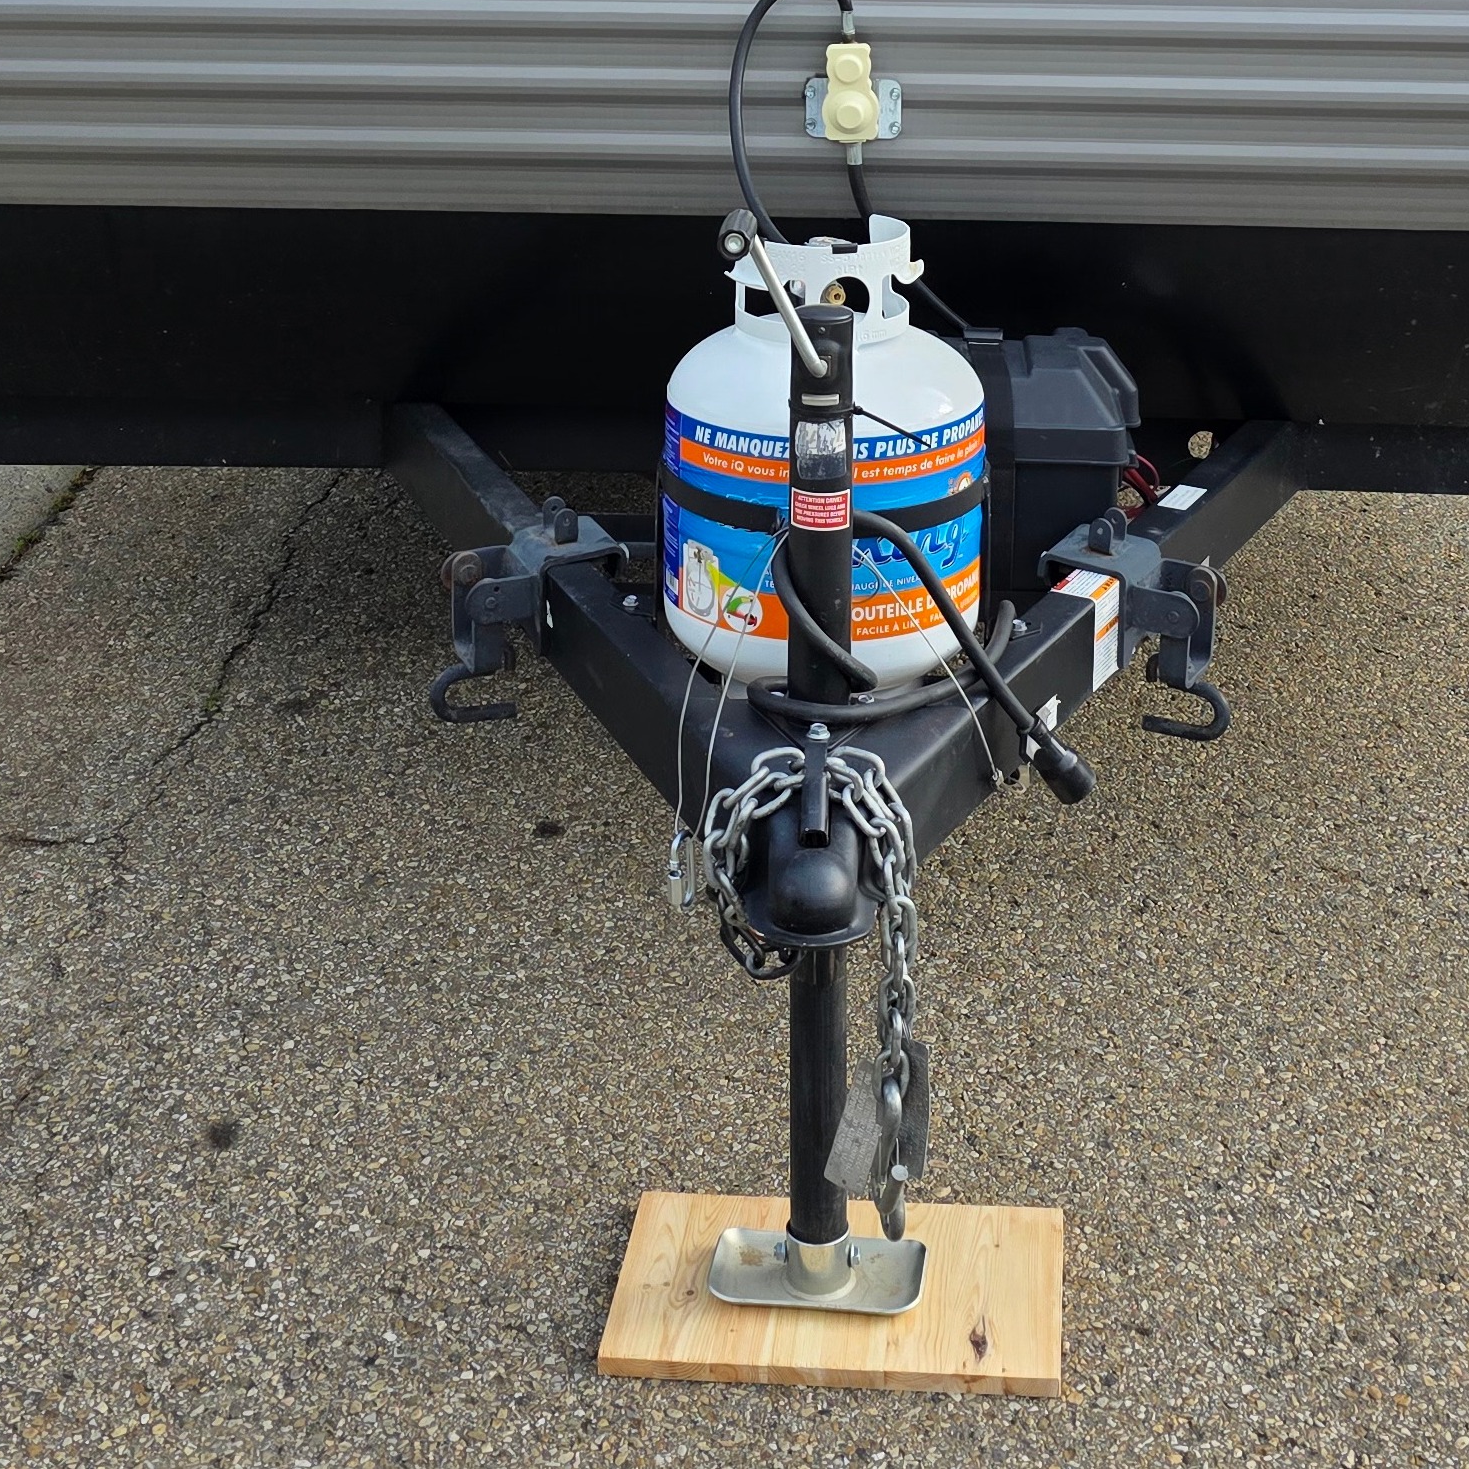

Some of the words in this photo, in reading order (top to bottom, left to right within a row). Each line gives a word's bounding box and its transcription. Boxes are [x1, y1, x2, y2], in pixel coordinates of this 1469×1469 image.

[694, 424, 712, 445] NE
[874, 437, 916, 458] PLUS
[920, 431, 939, 451] DE
[702, 451, 728, 469] Votre
[747, 464, 775, 478] vous
[861, 466, 881, 478] est
[883, 463, 917, 477] temps
[920, 458, 933, 471] de
[935, 452, 956, 467] faire
[851, 596, 924, 622] OUTEILLE
[856, 624, 890, 636] FACILE
